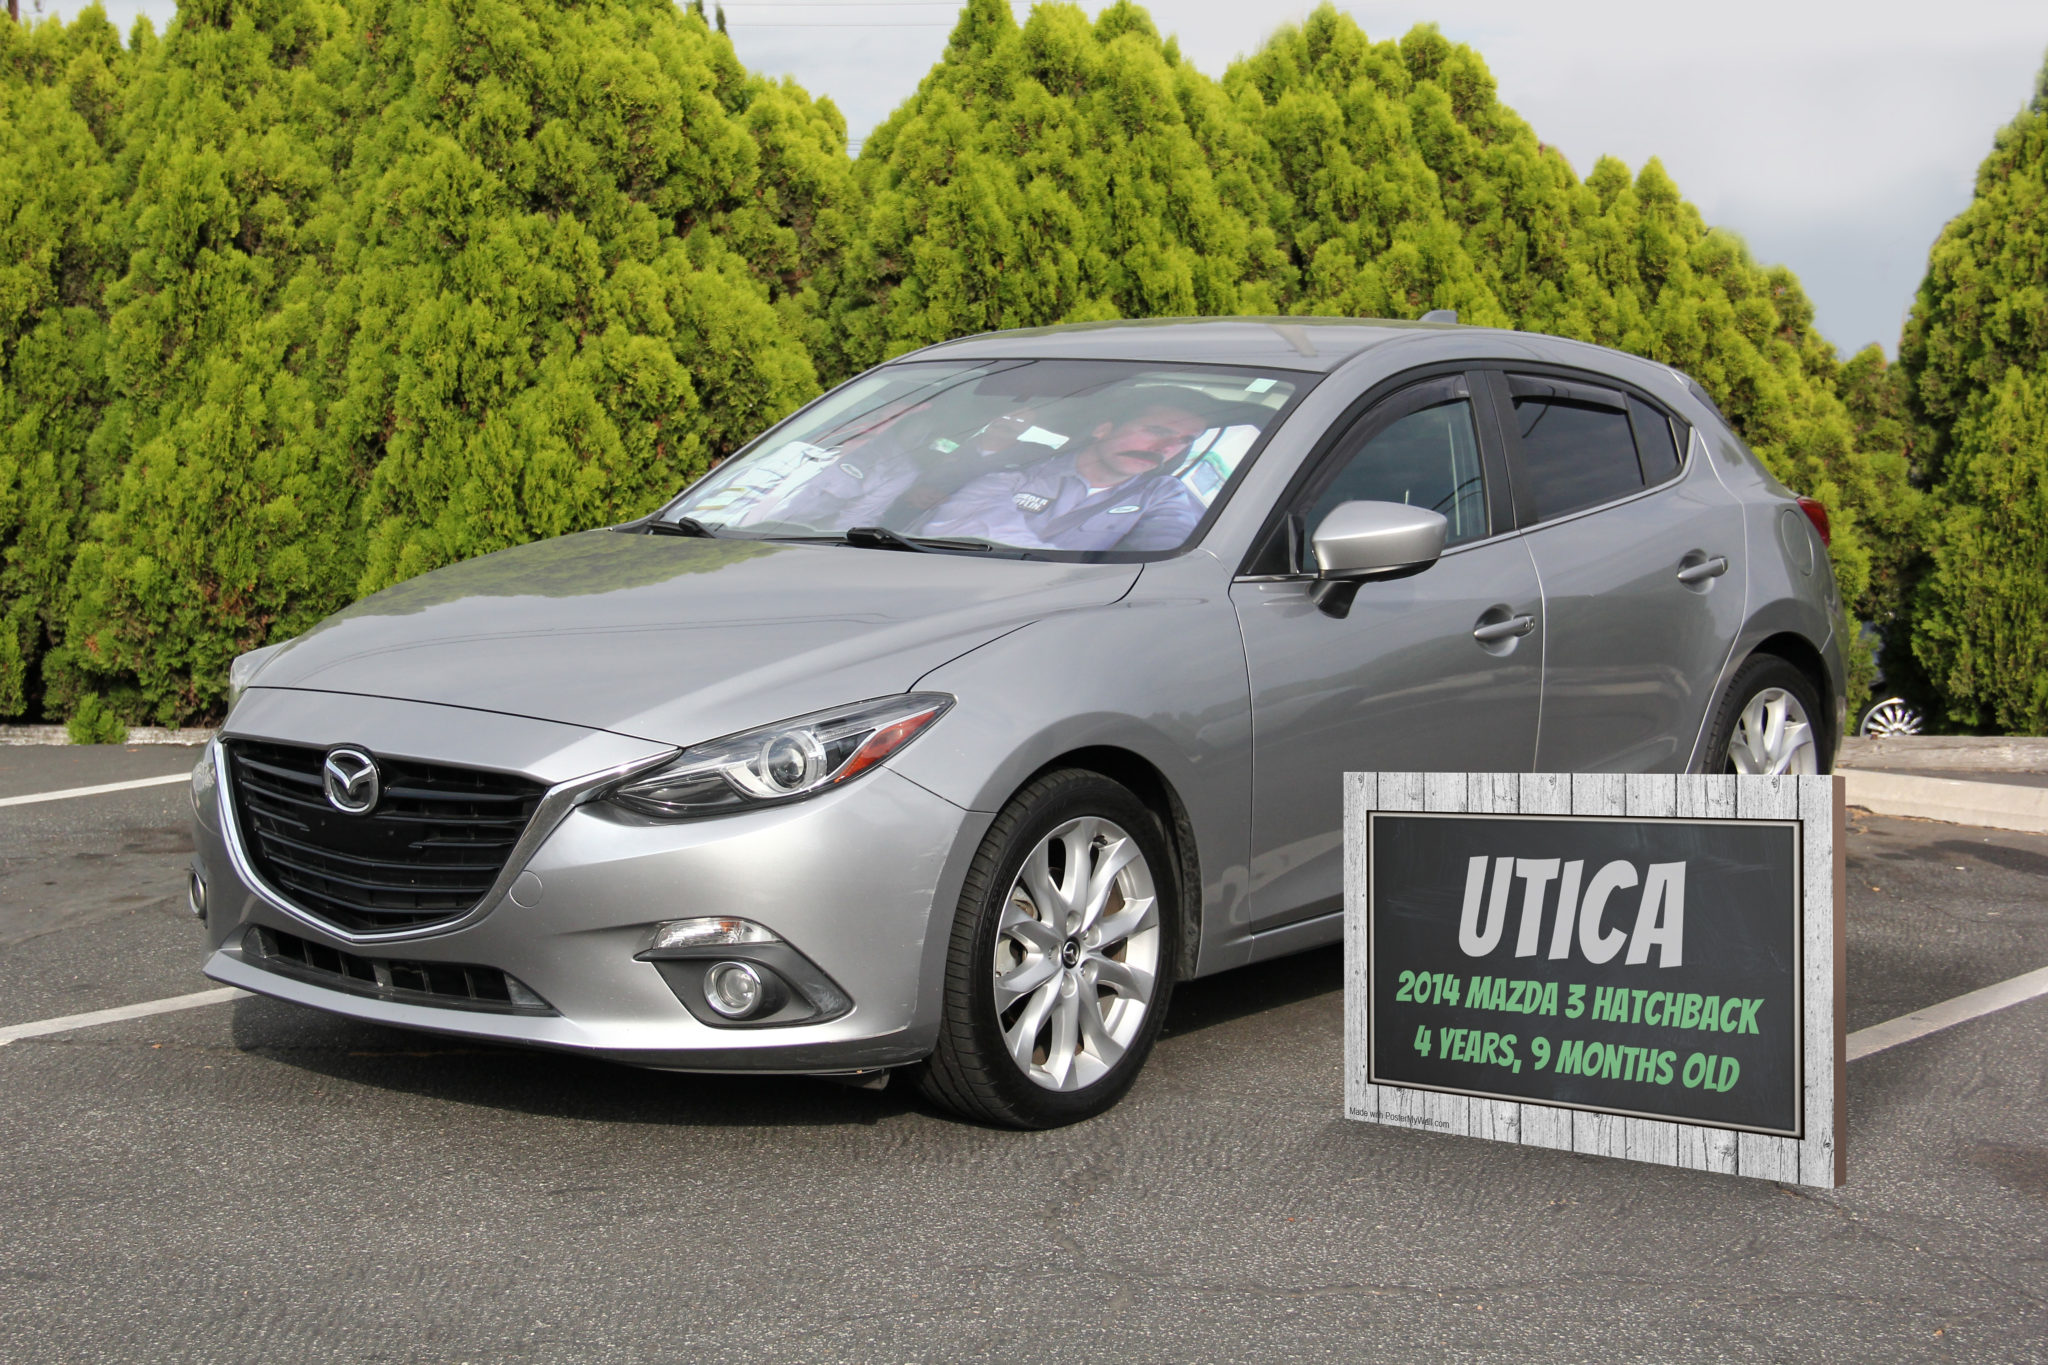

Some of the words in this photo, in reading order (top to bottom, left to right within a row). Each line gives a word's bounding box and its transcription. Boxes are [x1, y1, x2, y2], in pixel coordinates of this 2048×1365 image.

[1458, 855, 1687, 969] UTICA
[1396, 969, 1461, 1007] 2014
[1464, 975, 1559, 1018] MAZDA
[1564, 984, 1587, 1019] 3
[1591, 986, 1765, 1035] HATCHBACK
[1413, 1025, 1432, 1057] 4
[1439, 1027, 1523, 1074] YEARS,
[1530, 1036, 1551, 1071] 9
[1554, 1039, 1678, 1086] MONTHS
[1681, 1052, 1741, 1093] OLD
[1349, 1107, 1368, 1117] Made
[1385, 1112, 1450, 1128] PosterMyWall.com
